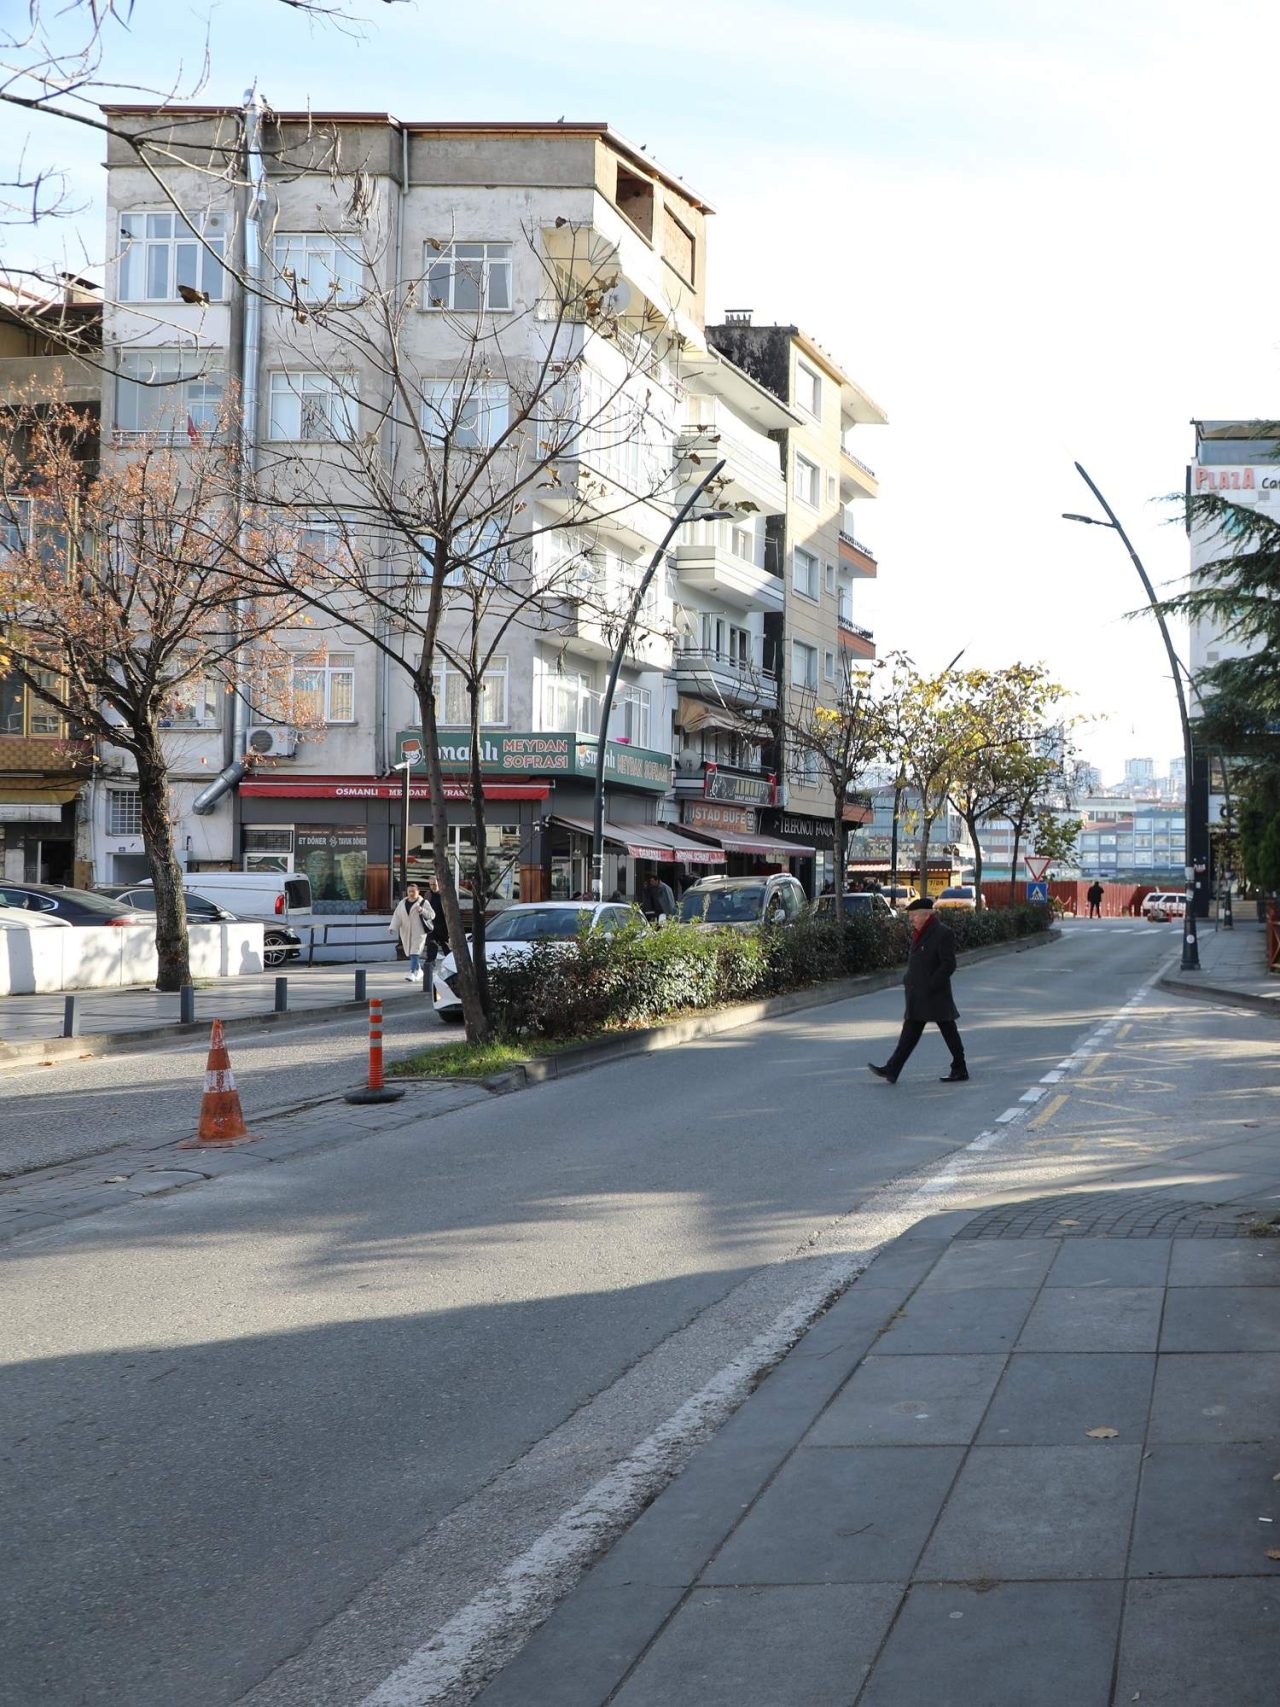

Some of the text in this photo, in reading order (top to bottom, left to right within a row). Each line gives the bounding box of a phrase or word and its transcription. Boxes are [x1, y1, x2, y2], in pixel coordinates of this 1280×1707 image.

[1196, 468, 1255, 489] PLAZA
[503, 739, 568, 753] MEYDAN
[503, 755, 569, 769] SOFRASI
[335, 788, 379, 796] OSMANLI
[389, 788, 427, 796] MEDAN
